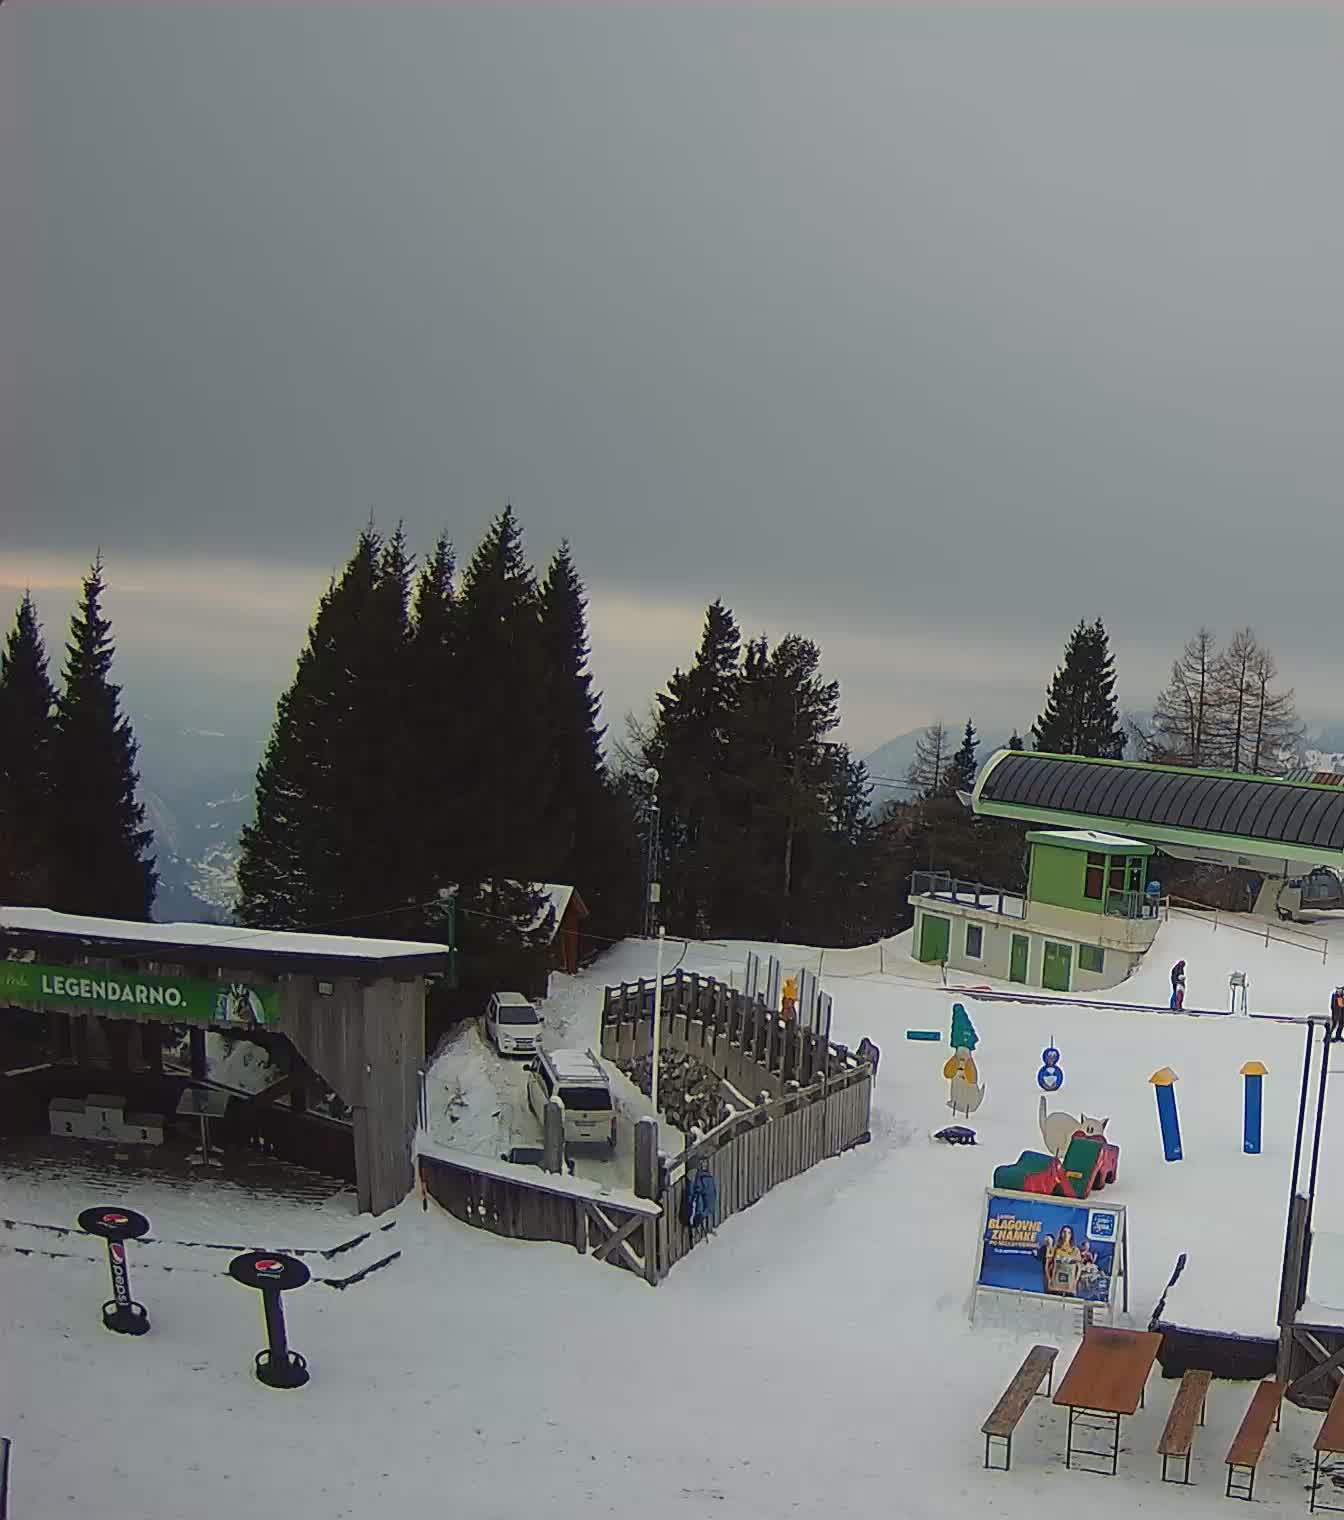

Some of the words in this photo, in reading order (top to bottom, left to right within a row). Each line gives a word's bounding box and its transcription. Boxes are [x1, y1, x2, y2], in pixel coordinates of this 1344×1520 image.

[41, 974, 188, 1007] LEGENDARNO.
[991, 1229, 1038, 1243] ZNAMKE
[112, 1264, 129, 1306] pepsi
